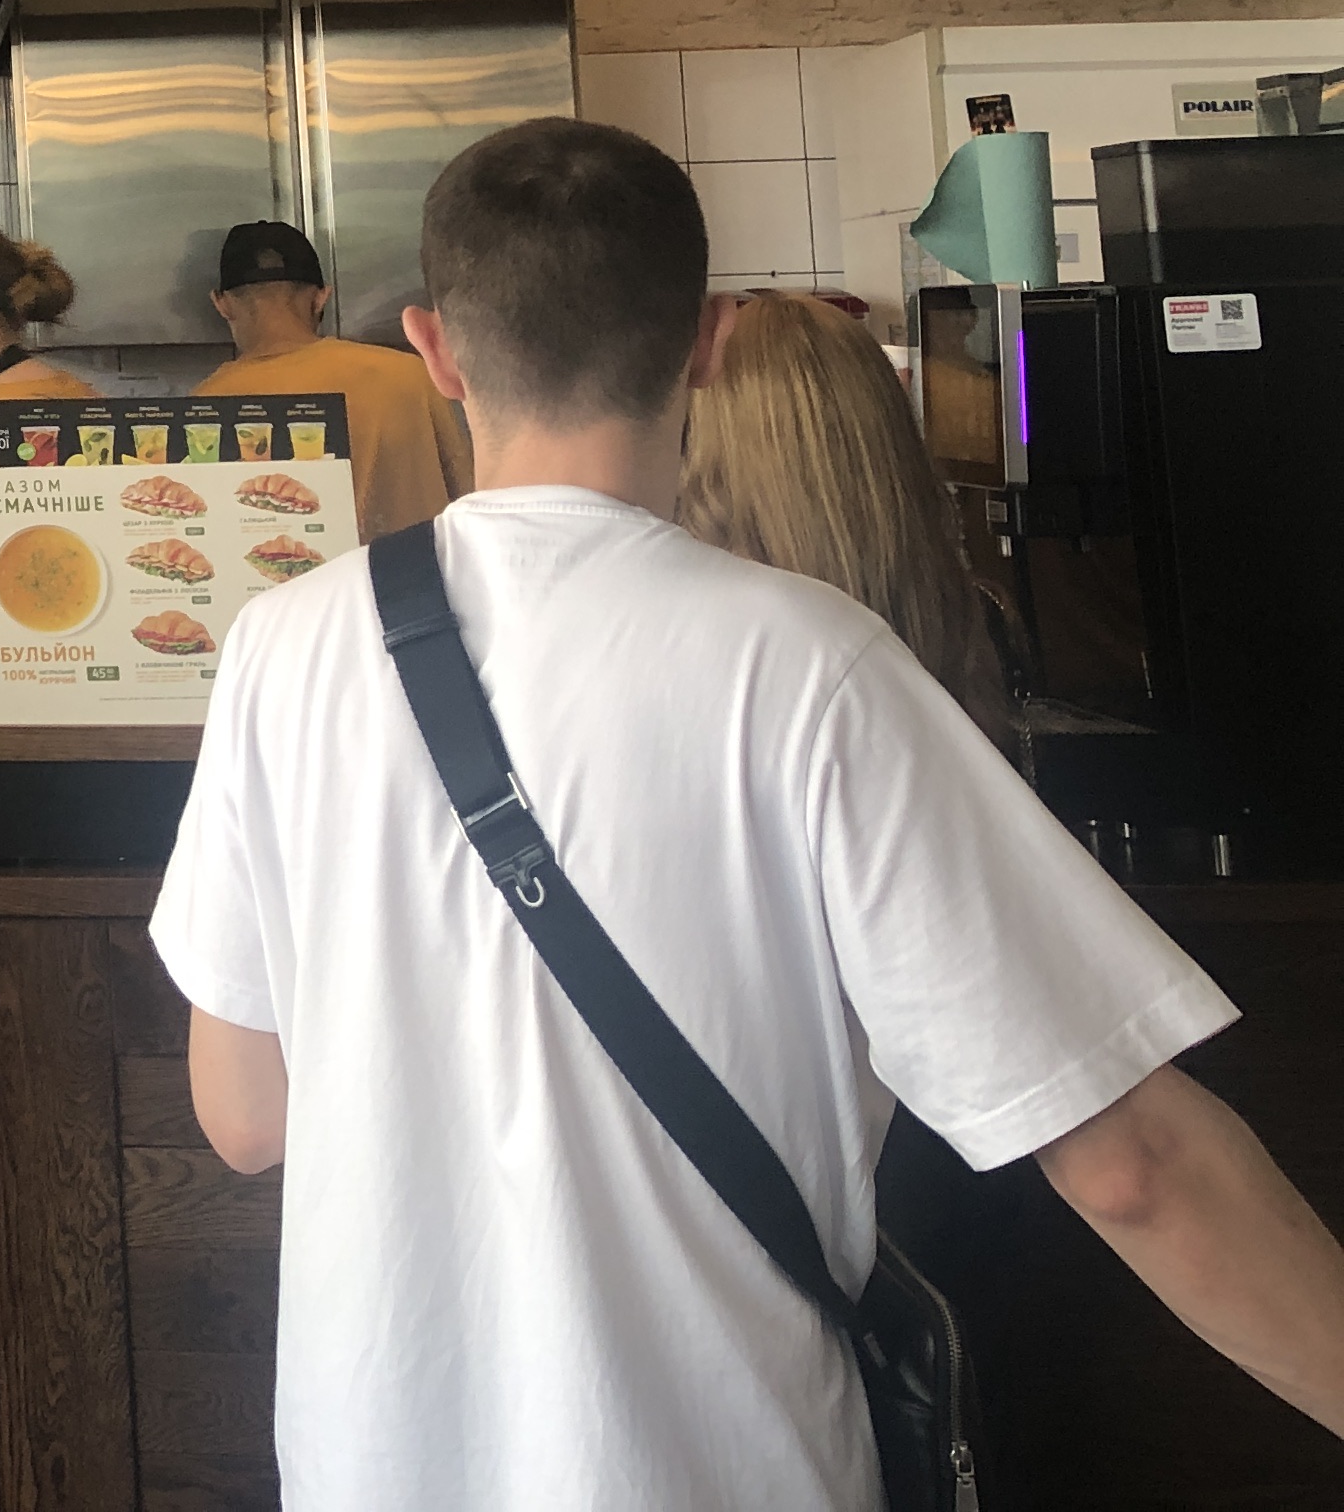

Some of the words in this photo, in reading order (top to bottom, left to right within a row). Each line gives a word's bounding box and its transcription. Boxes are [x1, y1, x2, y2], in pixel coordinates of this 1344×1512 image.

[1183, 99, 1254, 114] POLAIR
[0, 642, 95, 663] БУЛЬЙОН
[2, 669, 37, 681] 100%
[92, 669, 107, 679] 45
